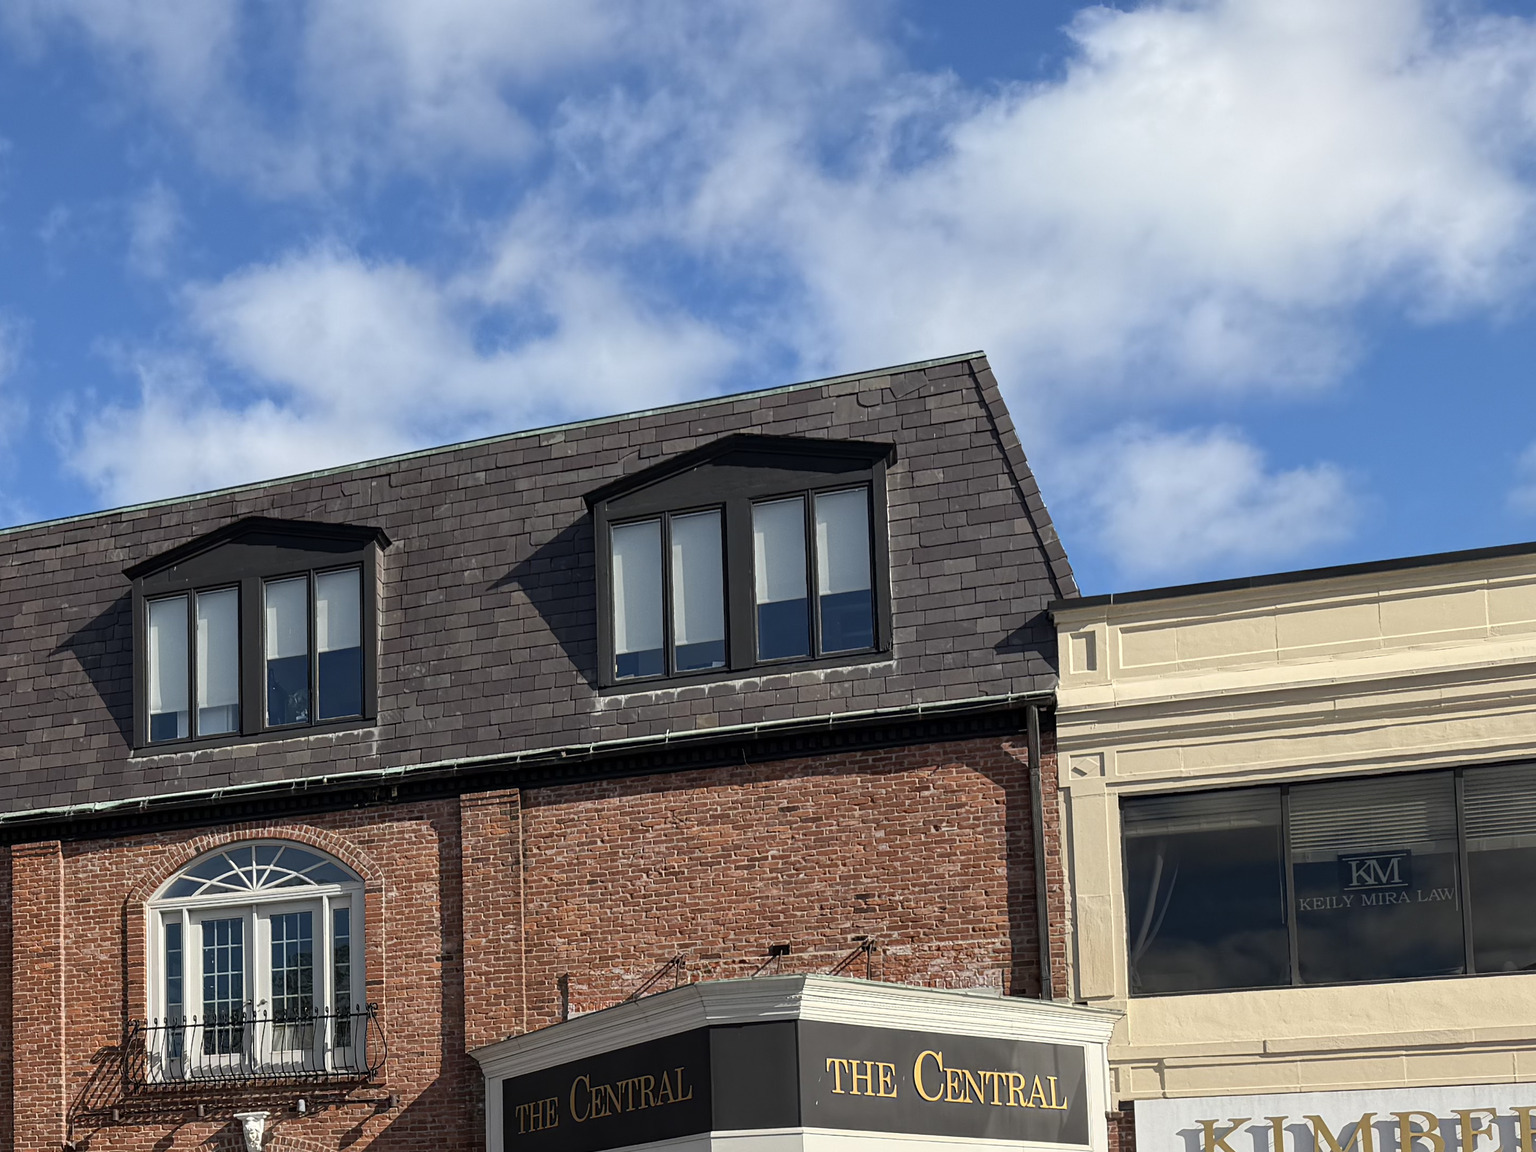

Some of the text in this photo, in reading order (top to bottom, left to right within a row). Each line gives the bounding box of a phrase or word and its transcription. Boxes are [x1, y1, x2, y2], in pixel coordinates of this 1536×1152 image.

[1348, 857, 1403, 886] KM
[1299, 887, 1455, 911] KEILY MIRA LAW
[516, 1066, 693, 1135] THE CENTRAL
[826, 1049, 1068, 1110] THE CENTRAL
